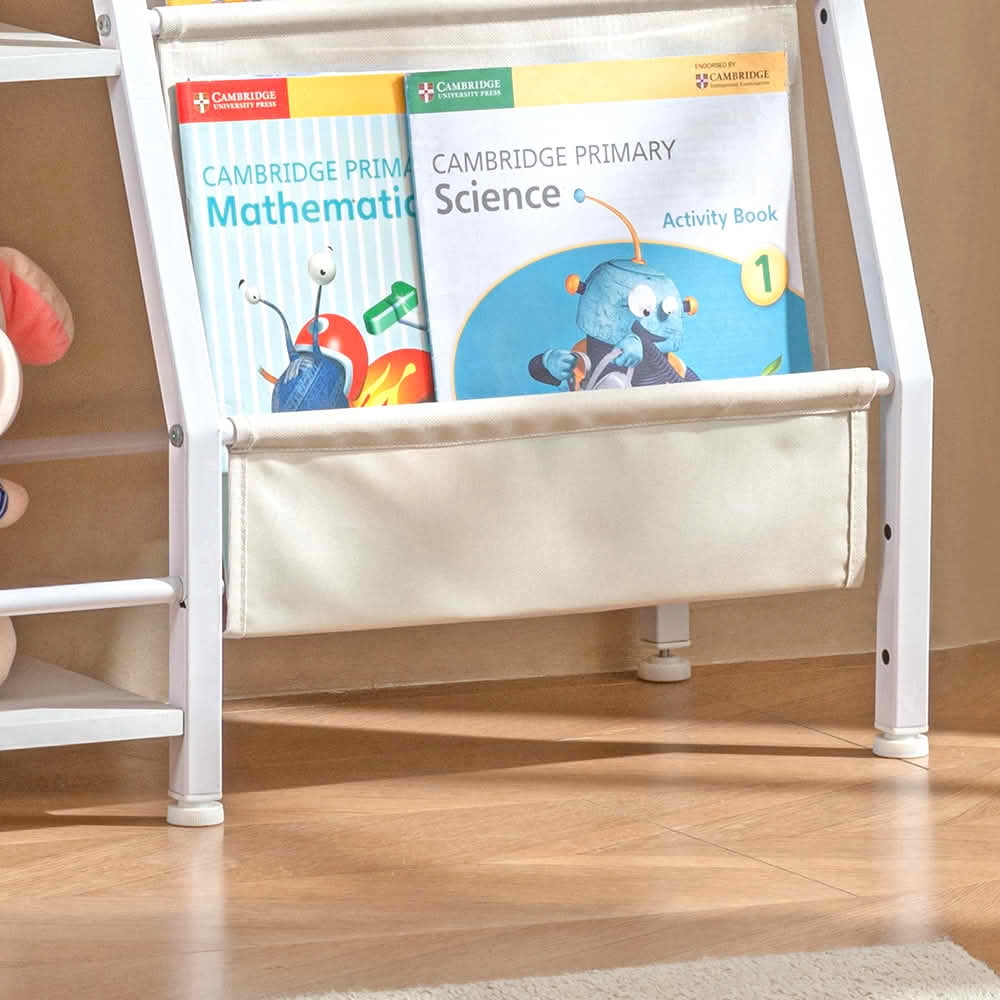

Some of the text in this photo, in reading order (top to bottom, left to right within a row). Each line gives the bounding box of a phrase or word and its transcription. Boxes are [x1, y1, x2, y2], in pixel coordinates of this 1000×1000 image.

[709, 70, 770, 81] CAMBRIDGE
[436, 79, 501, 93] CAMBRIDGE
[438, 89, 502, 99] UNIVERSITY PRESS
[211, 91, 277, 103] CAMBRIDGE
[213, 102, 254, 110] UNIVERSITY
[432, 139, 677, 175] CAMBRIDGE PRIMARY
[202, 160, 338, 187] CAMBRIDGE
[435, 180, 561, 215] Science
[663, 205, 779, 231] Activity Book
[754, 254, 773, 293] 1
